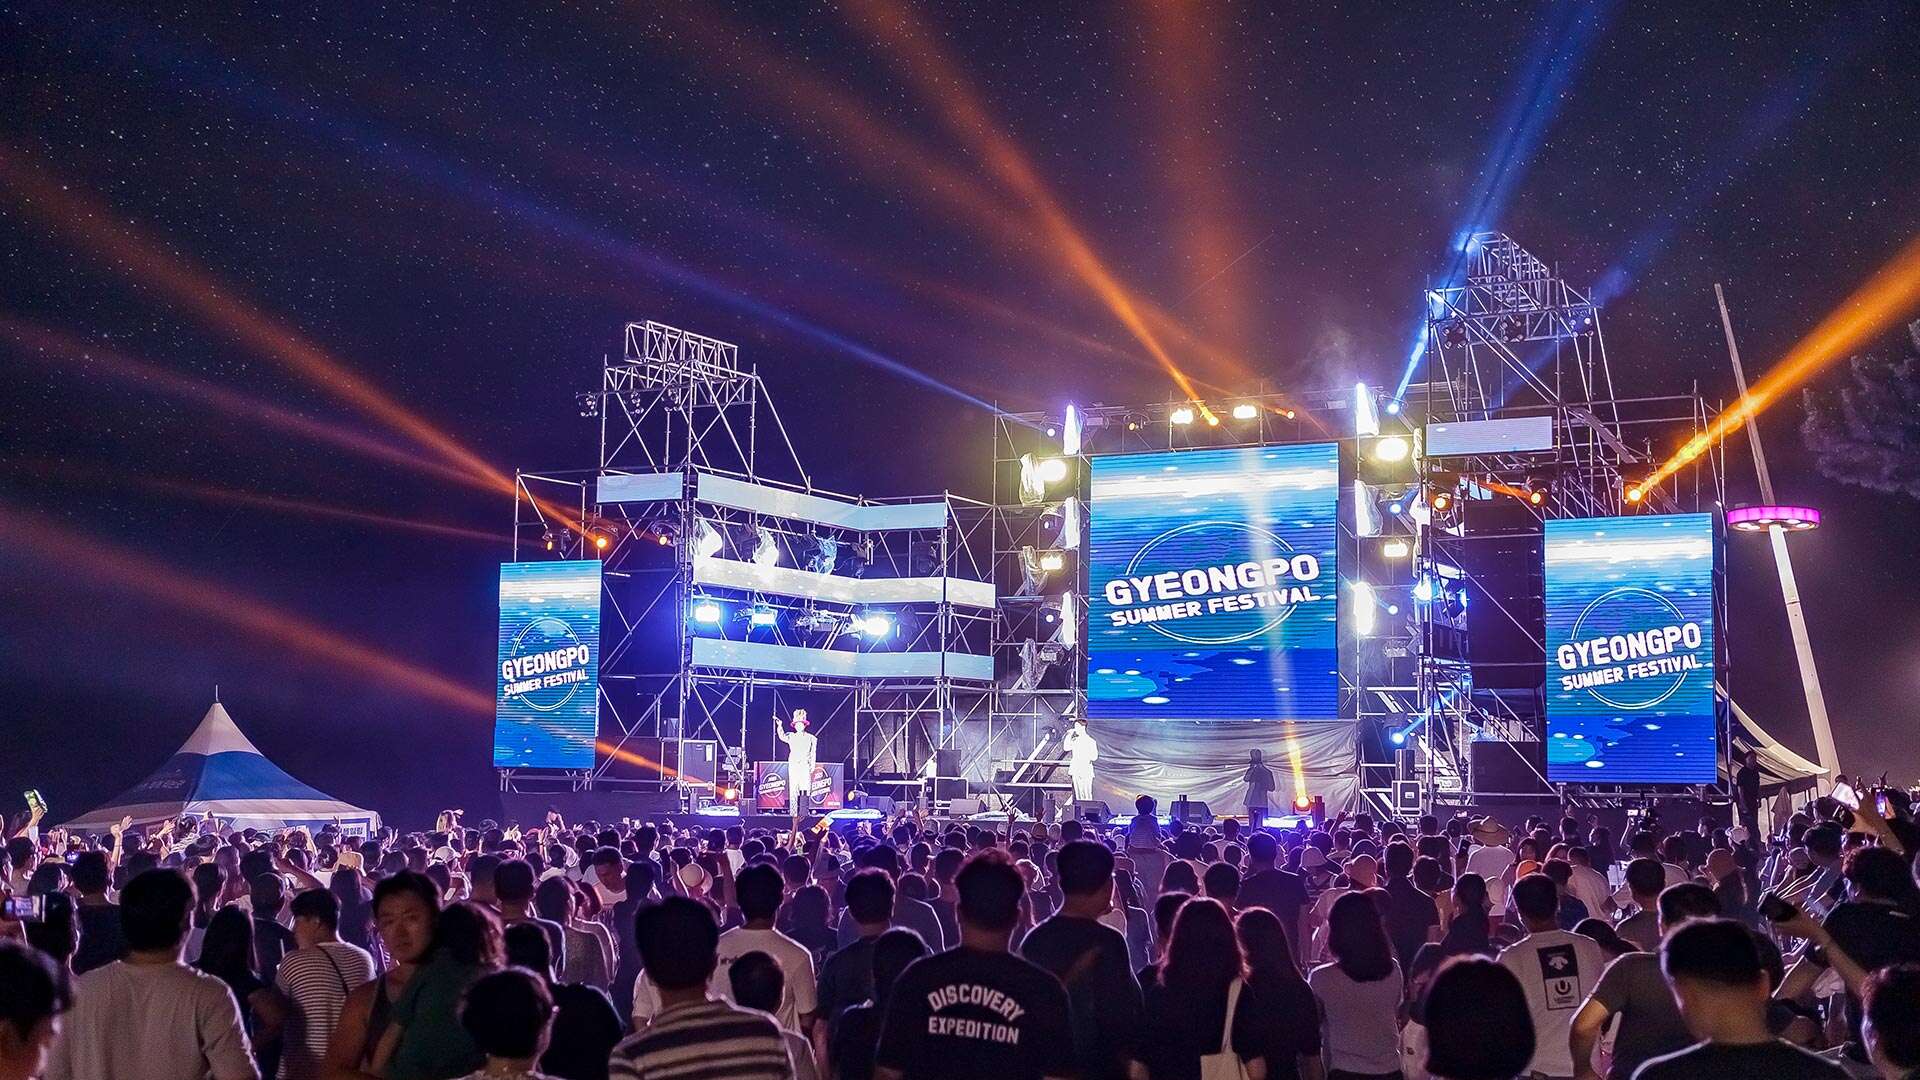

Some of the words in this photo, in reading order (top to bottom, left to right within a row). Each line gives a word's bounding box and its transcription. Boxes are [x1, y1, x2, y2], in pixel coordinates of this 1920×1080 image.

[1104, 553, 1320, 606] GYEONGPO
[1110, 601, 1203, 627] SUMMER
[1207, 586, 1321, 615] FESTIVAL
[502, 644, 590, 680] GYEONGPO
[1557, 622, 1702, 670] GYEONGPO
[503, 678, 542, 697] SUMMER
[543, 669, 590, 688] FESTIVAL
[1562, 667, 1624, 691] SUMMER
[1627, 654, 1703, 680] FESTIVAL
[927, 983, 1025, 1021] DISCOVERY
[928, 1016, 1020, 1044] EXPEDITION
